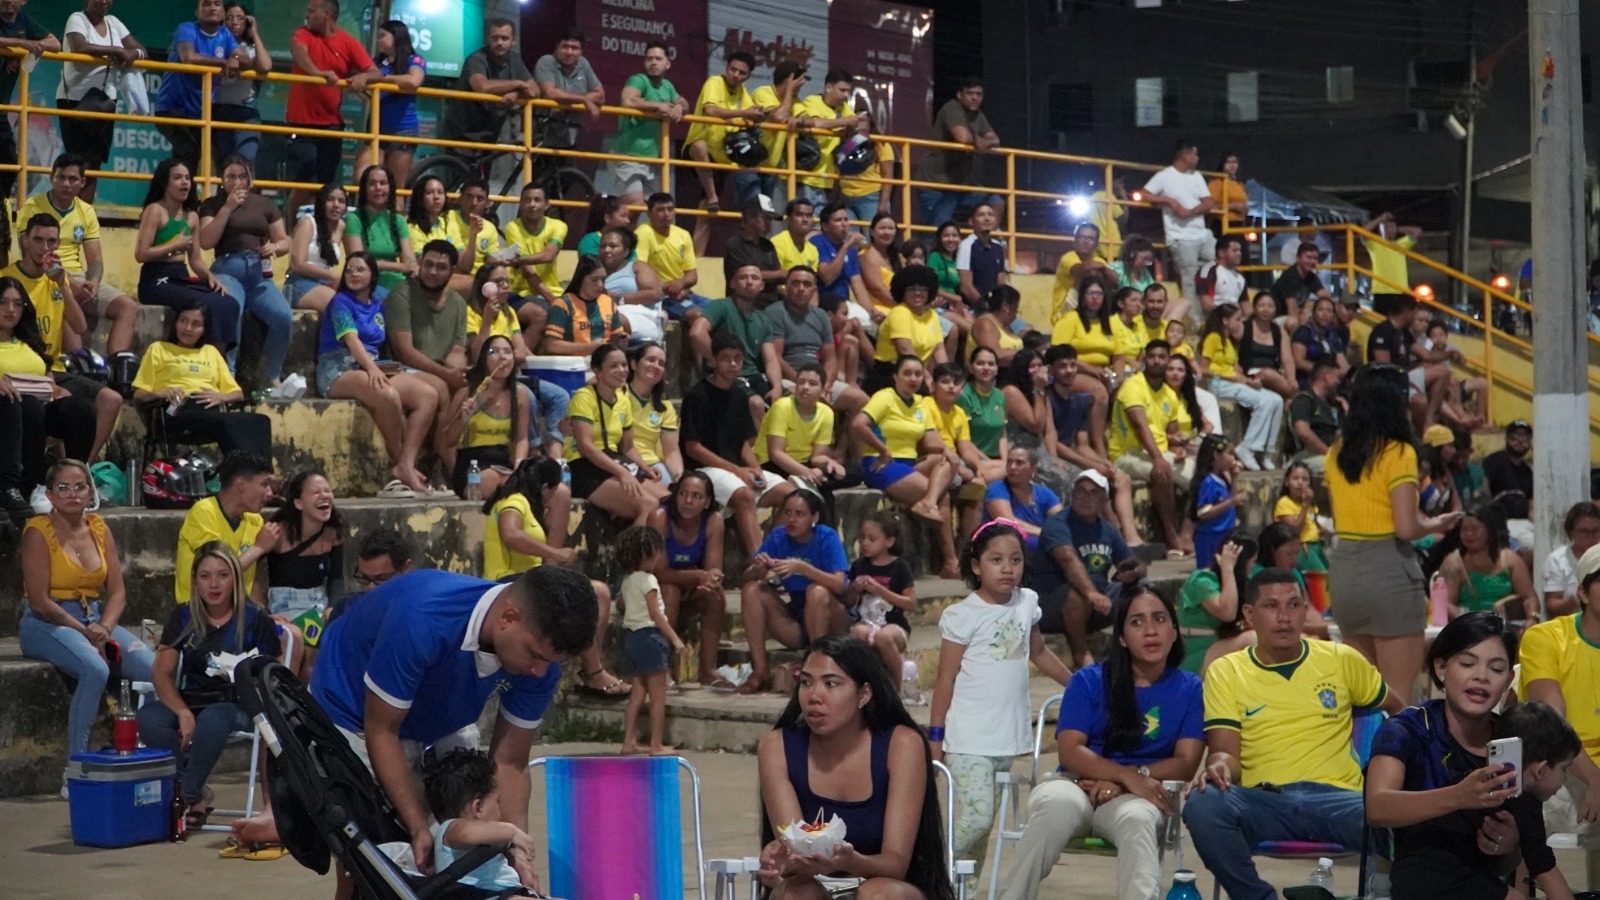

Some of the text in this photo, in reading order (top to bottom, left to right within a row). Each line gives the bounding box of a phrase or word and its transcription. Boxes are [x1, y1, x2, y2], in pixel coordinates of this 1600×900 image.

[601, 13, 676, 40] E SEGURANÇA
[601, 36, 619, 52] DO
[1079, 543, 1113, 557] BRASIL
